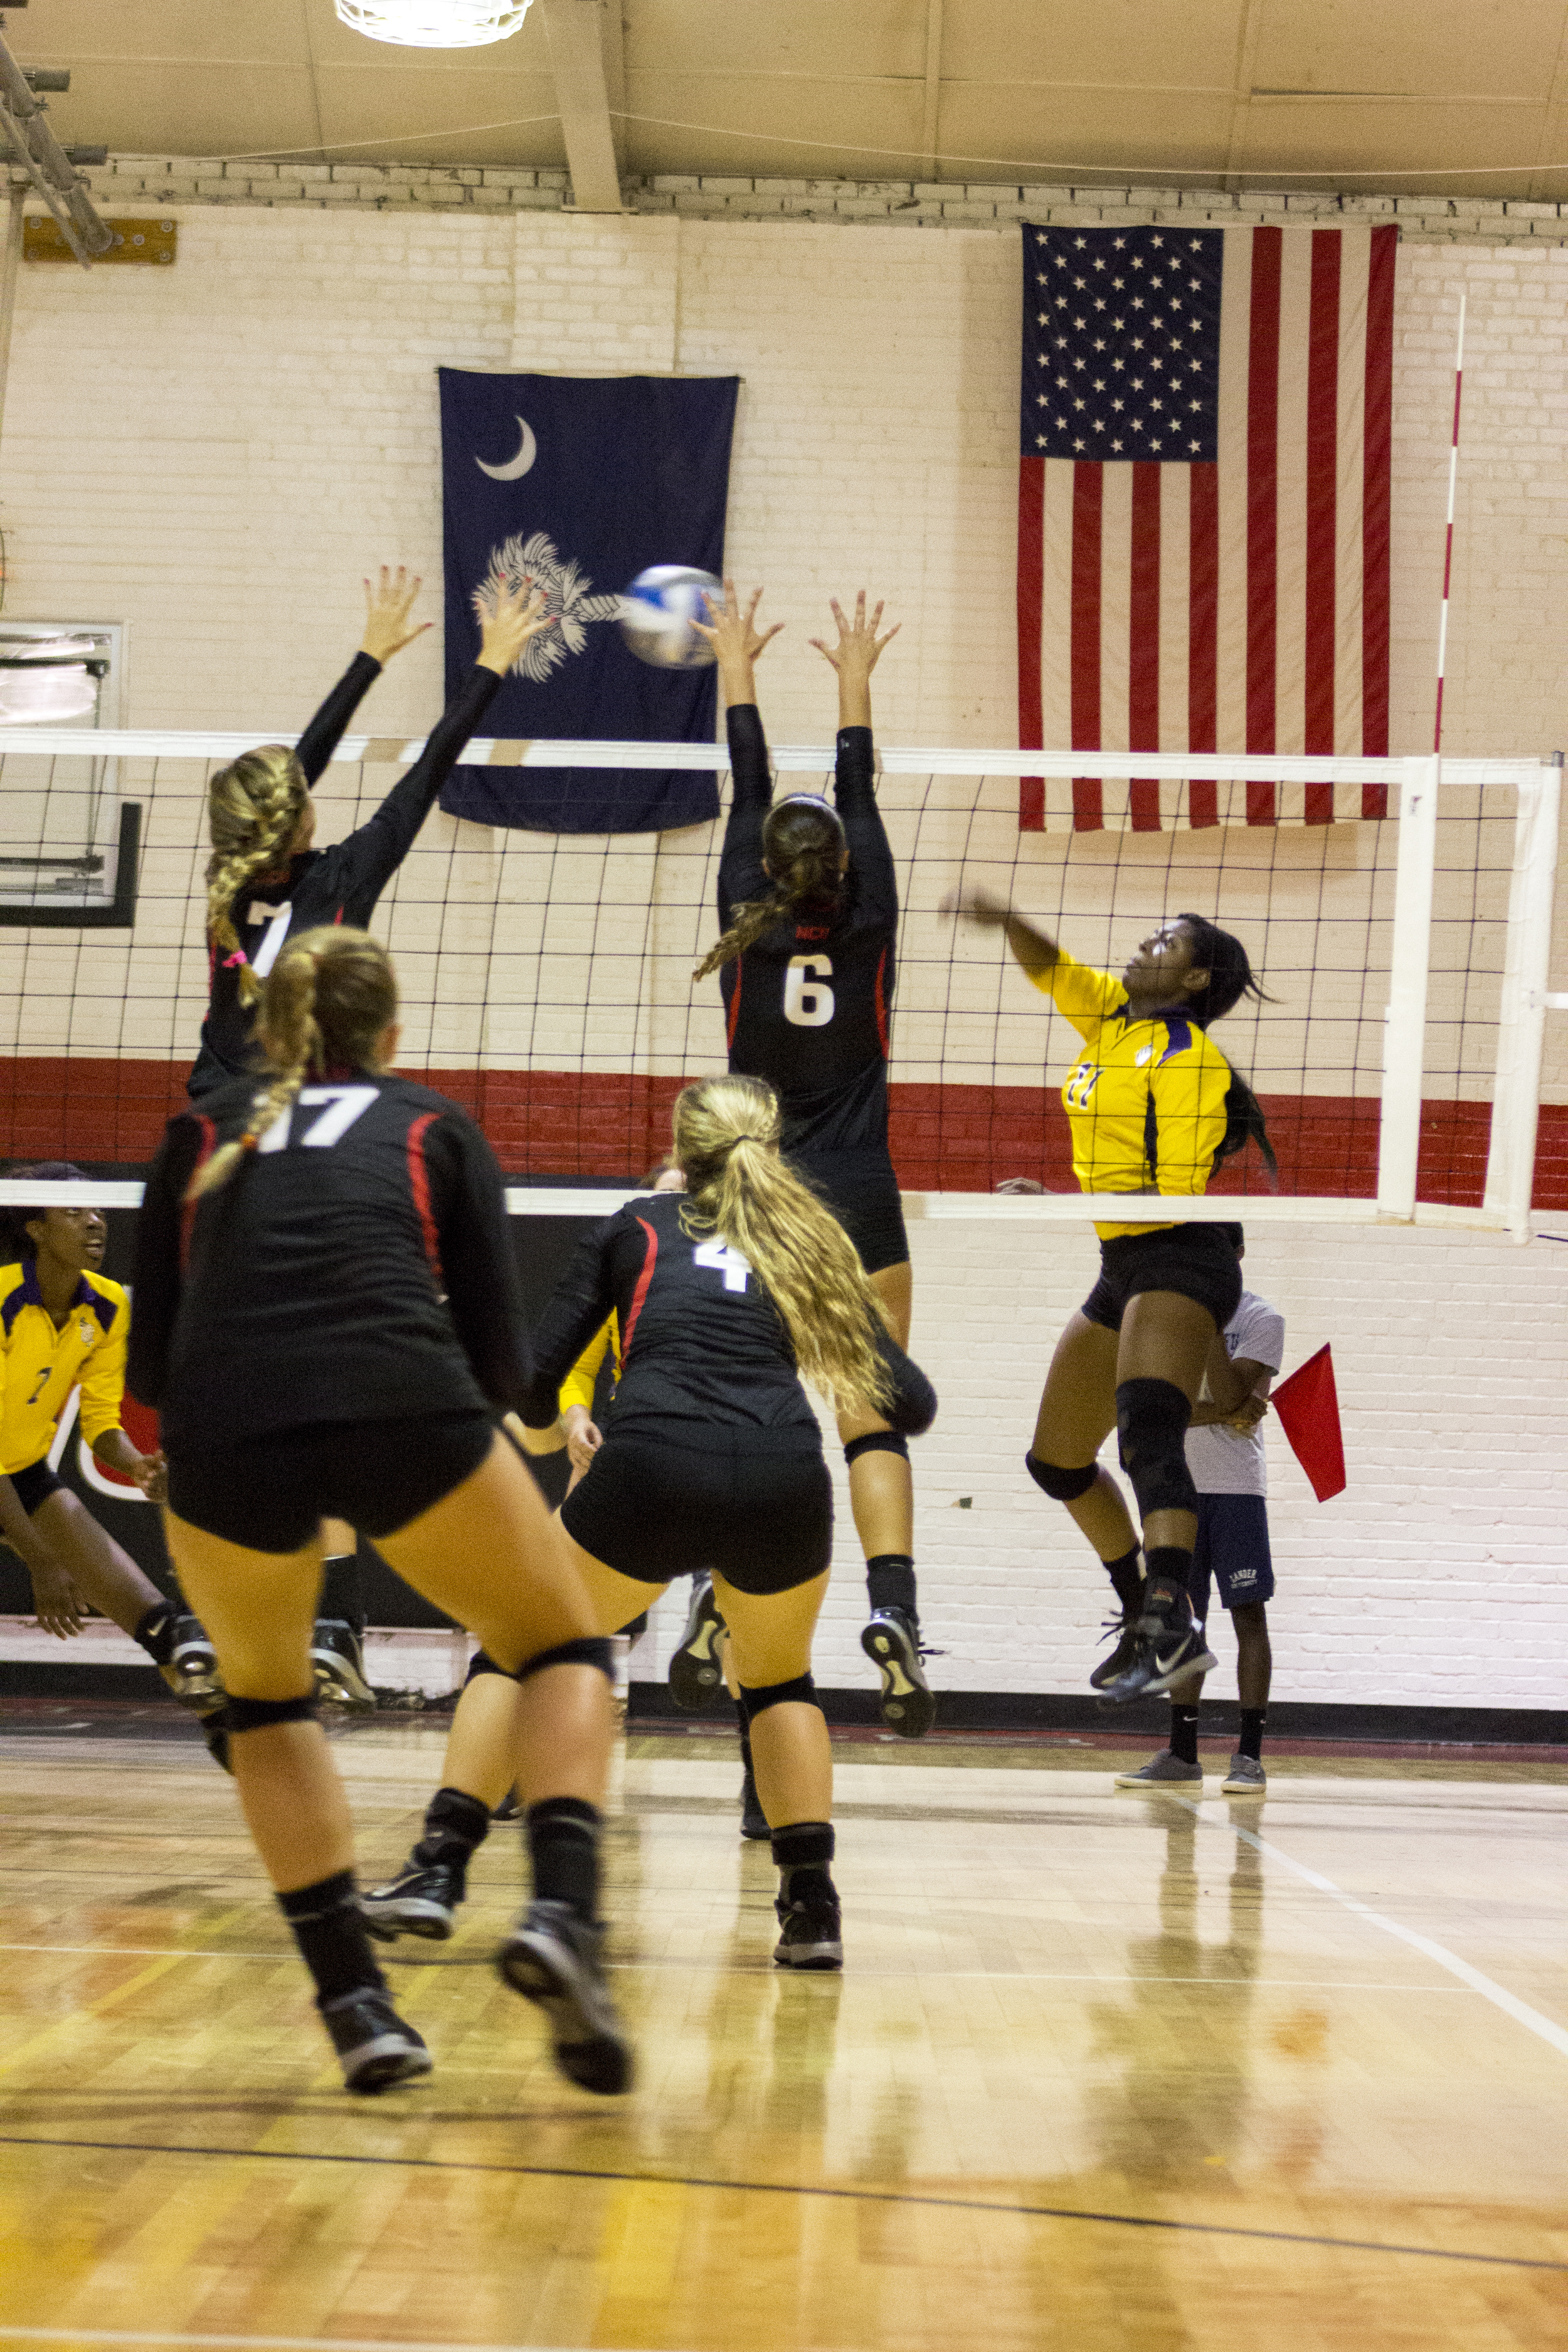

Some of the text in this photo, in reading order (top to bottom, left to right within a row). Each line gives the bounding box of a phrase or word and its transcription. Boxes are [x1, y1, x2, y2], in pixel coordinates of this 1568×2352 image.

[246, 901, 292, 978] 7
[783, 954, 835, 1025] 6
[692, 1233, 751, 1293] 4
[27, 1366, 54, 1406] 7
